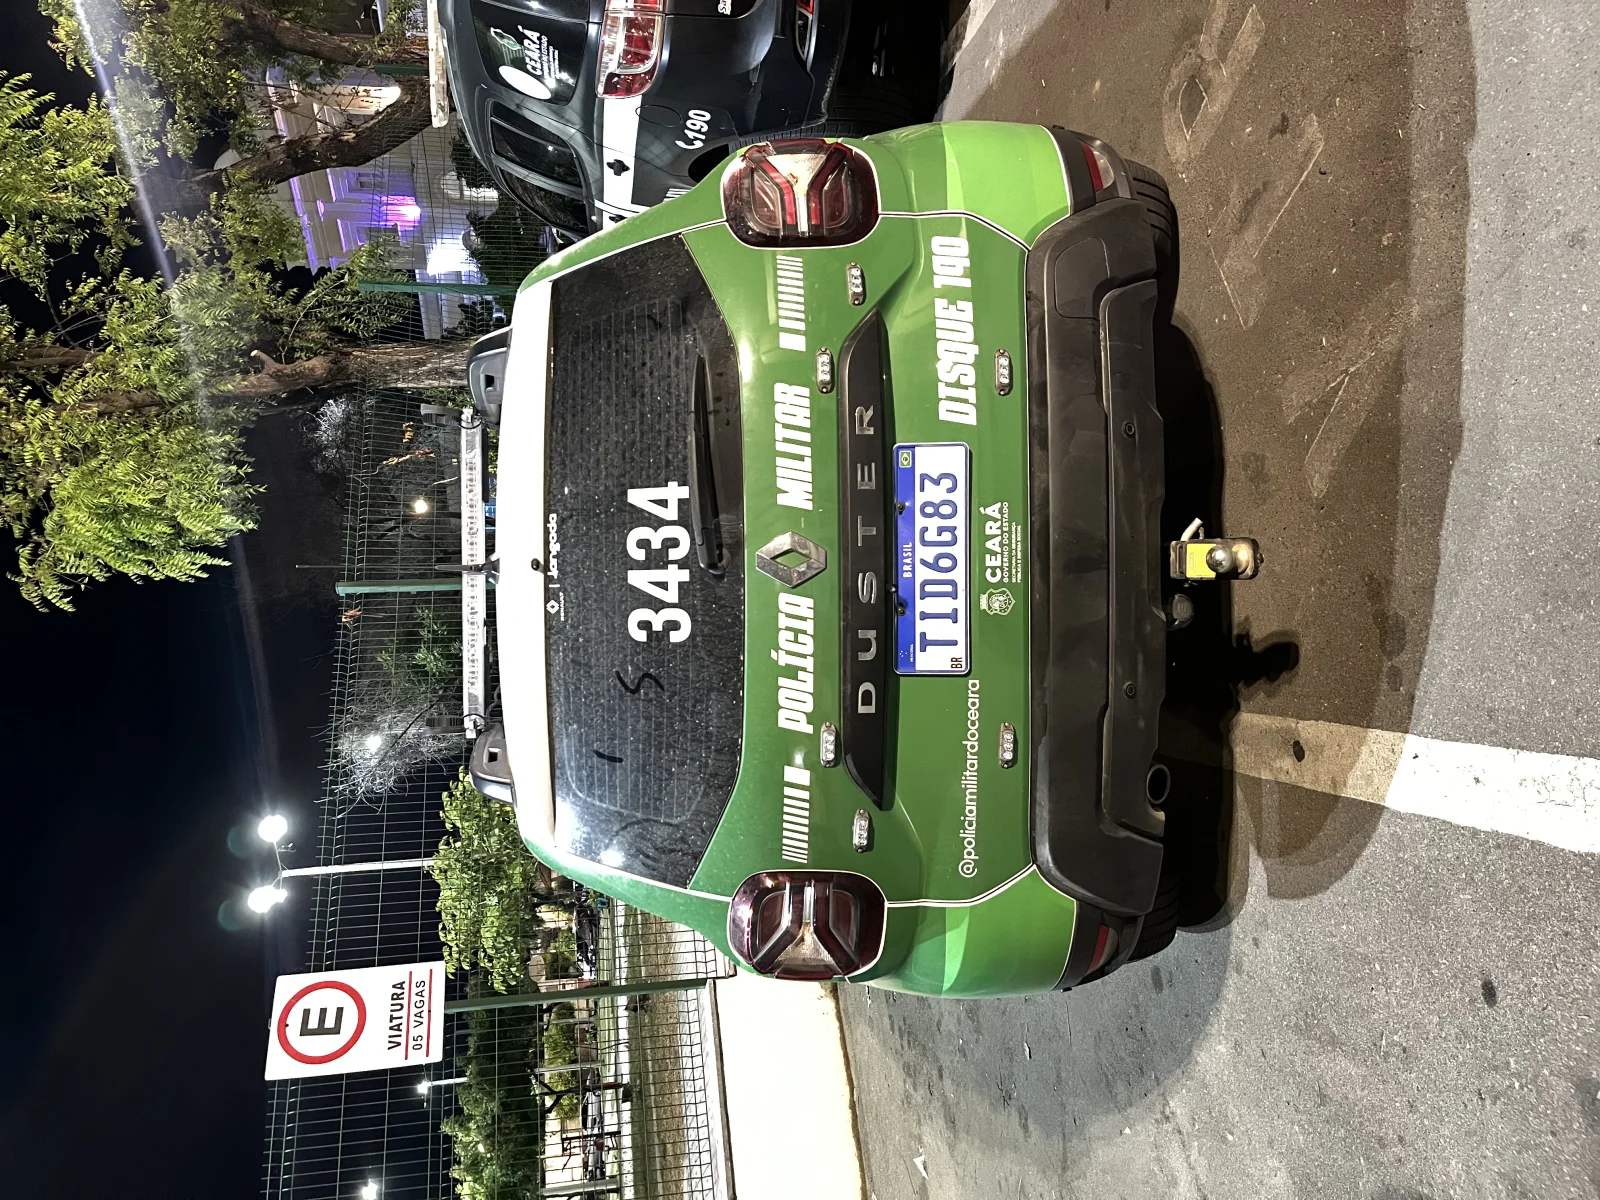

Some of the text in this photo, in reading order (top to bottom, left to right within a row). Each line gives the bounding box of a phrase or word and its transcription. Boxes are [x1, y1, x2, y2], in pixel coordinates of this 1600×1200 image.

[517, 24, 542, 76] CEARÁ
[683, 109, 712, 140] 190
[930, 236, 979, 426] DISQUE 190
[626, 480, 692, 643] 3434
[769, 381, 815, 735] POLÍCIA MILITAR
[855, 404, 877, 714] DUSTER
[902, 542, 912, 578] BRASIL
[919, 472, 958, 653] TID6G83
[979, 501, 1002, 583] CEARÁ
[1003, 532, 1009, 544] DO
[950, 657, 963, 669] BR
[957, 678, 981, 878] @policiamilitardoceara
[299, 1006, 344, 1036] E
[387, 980, 406, 1051] VIATURA
[411, 980, 426, 1051] 05 VAGAS
